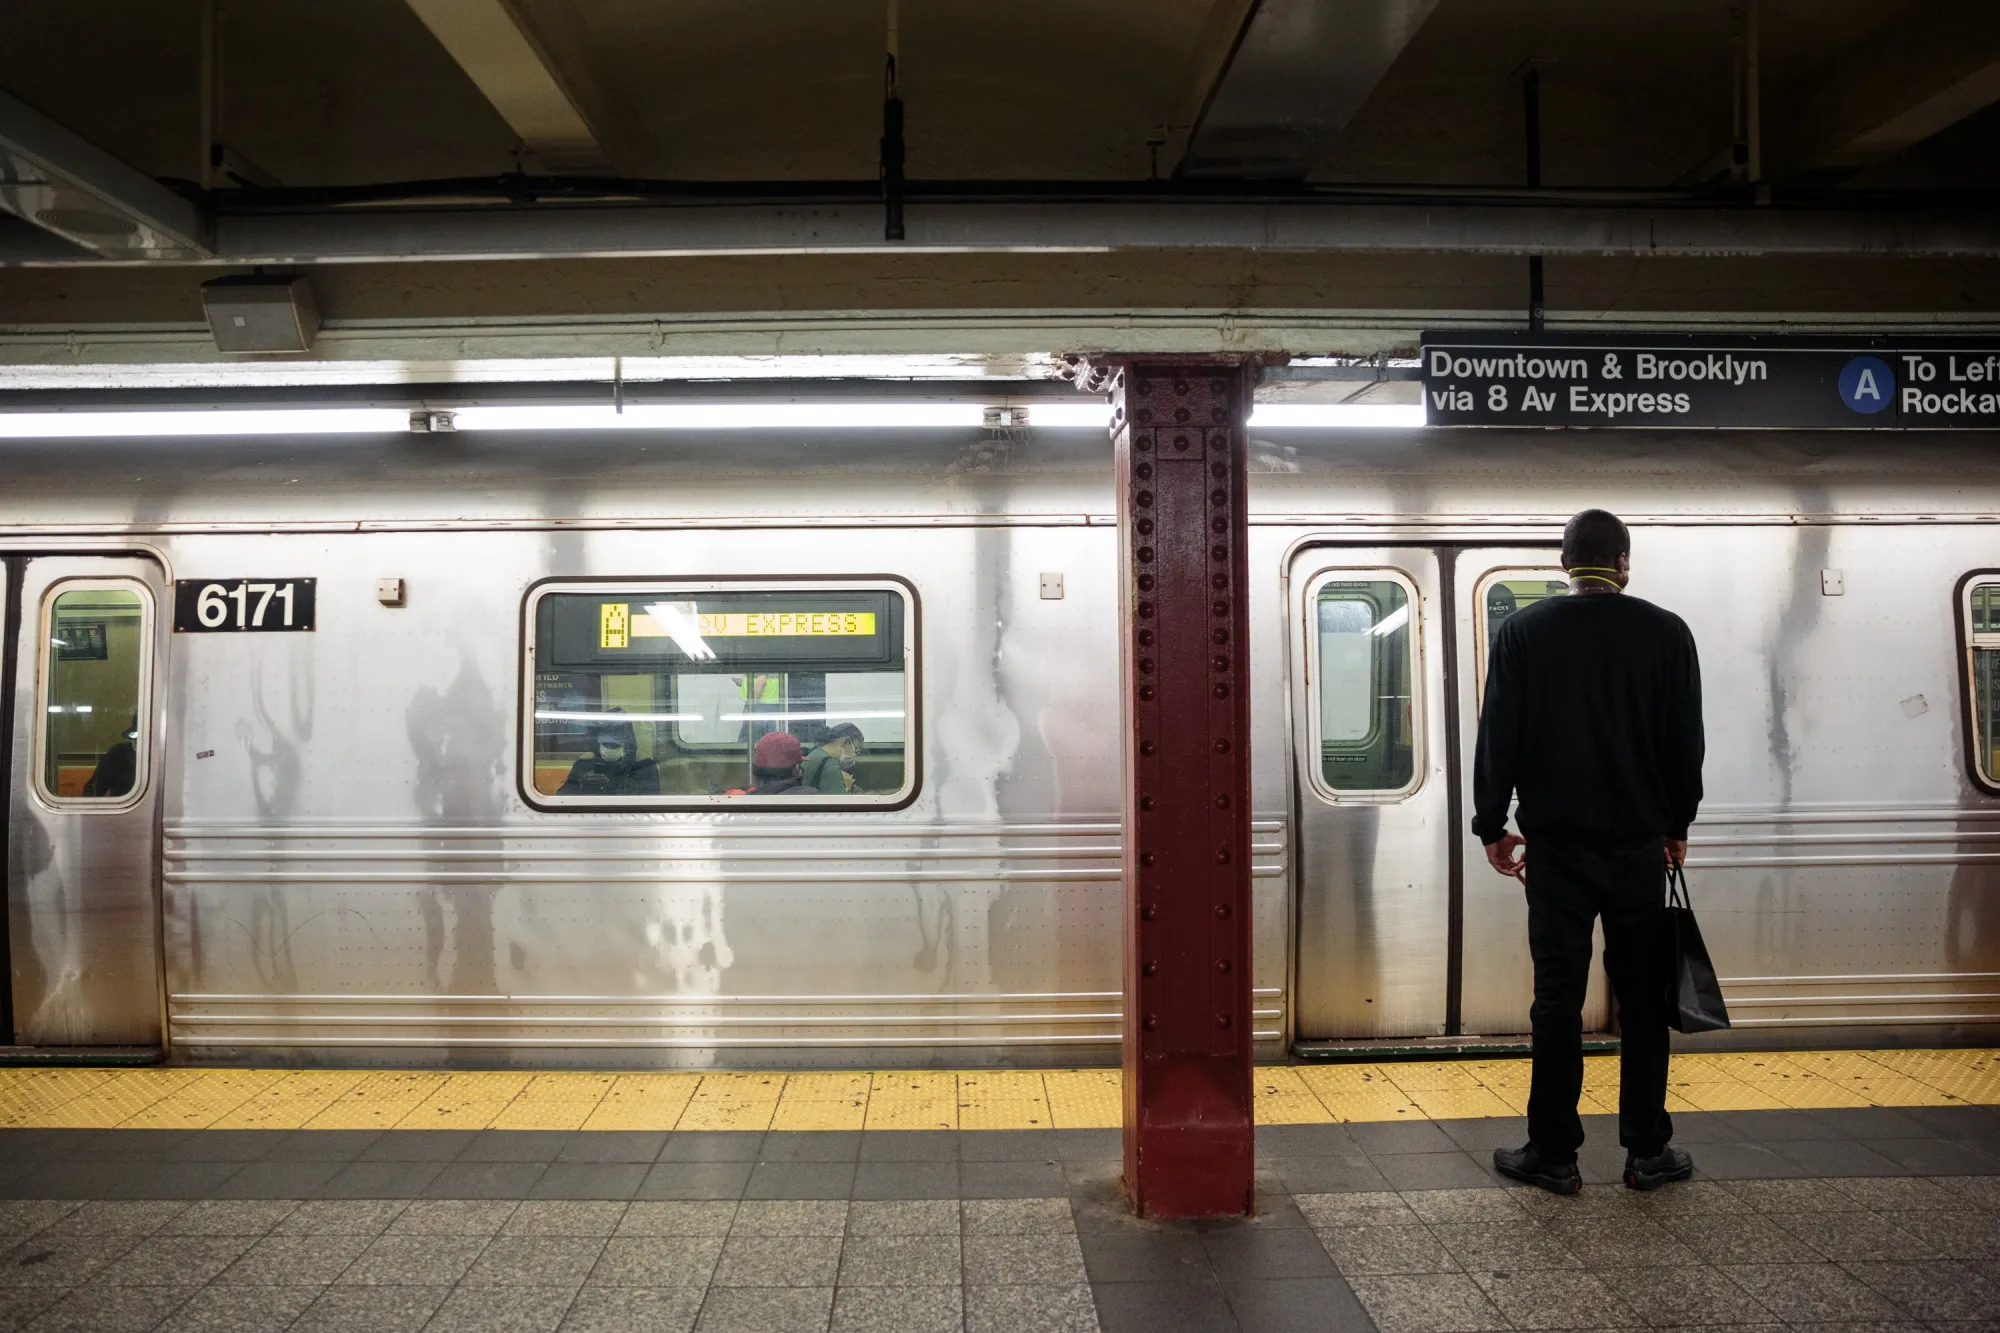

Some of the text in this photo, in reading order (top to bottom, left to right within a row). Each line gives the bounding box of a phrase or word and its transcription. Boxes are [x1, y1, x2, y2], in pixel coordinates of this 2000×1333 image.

[1430, 351, 1767, 386] Downtown & Brooklyn
[1902, 355, 2000, 382] To Lef
[1854, 370, 1881, 400] A
[1902, 387, 2000, 414] Rocka
[1431, 385, 1691, 418] via 8 Av Express
[197, 583, 295, 628] 6171
[605, 605, 625, 647] A
[746, 613, 857, 634] EXPRESS
